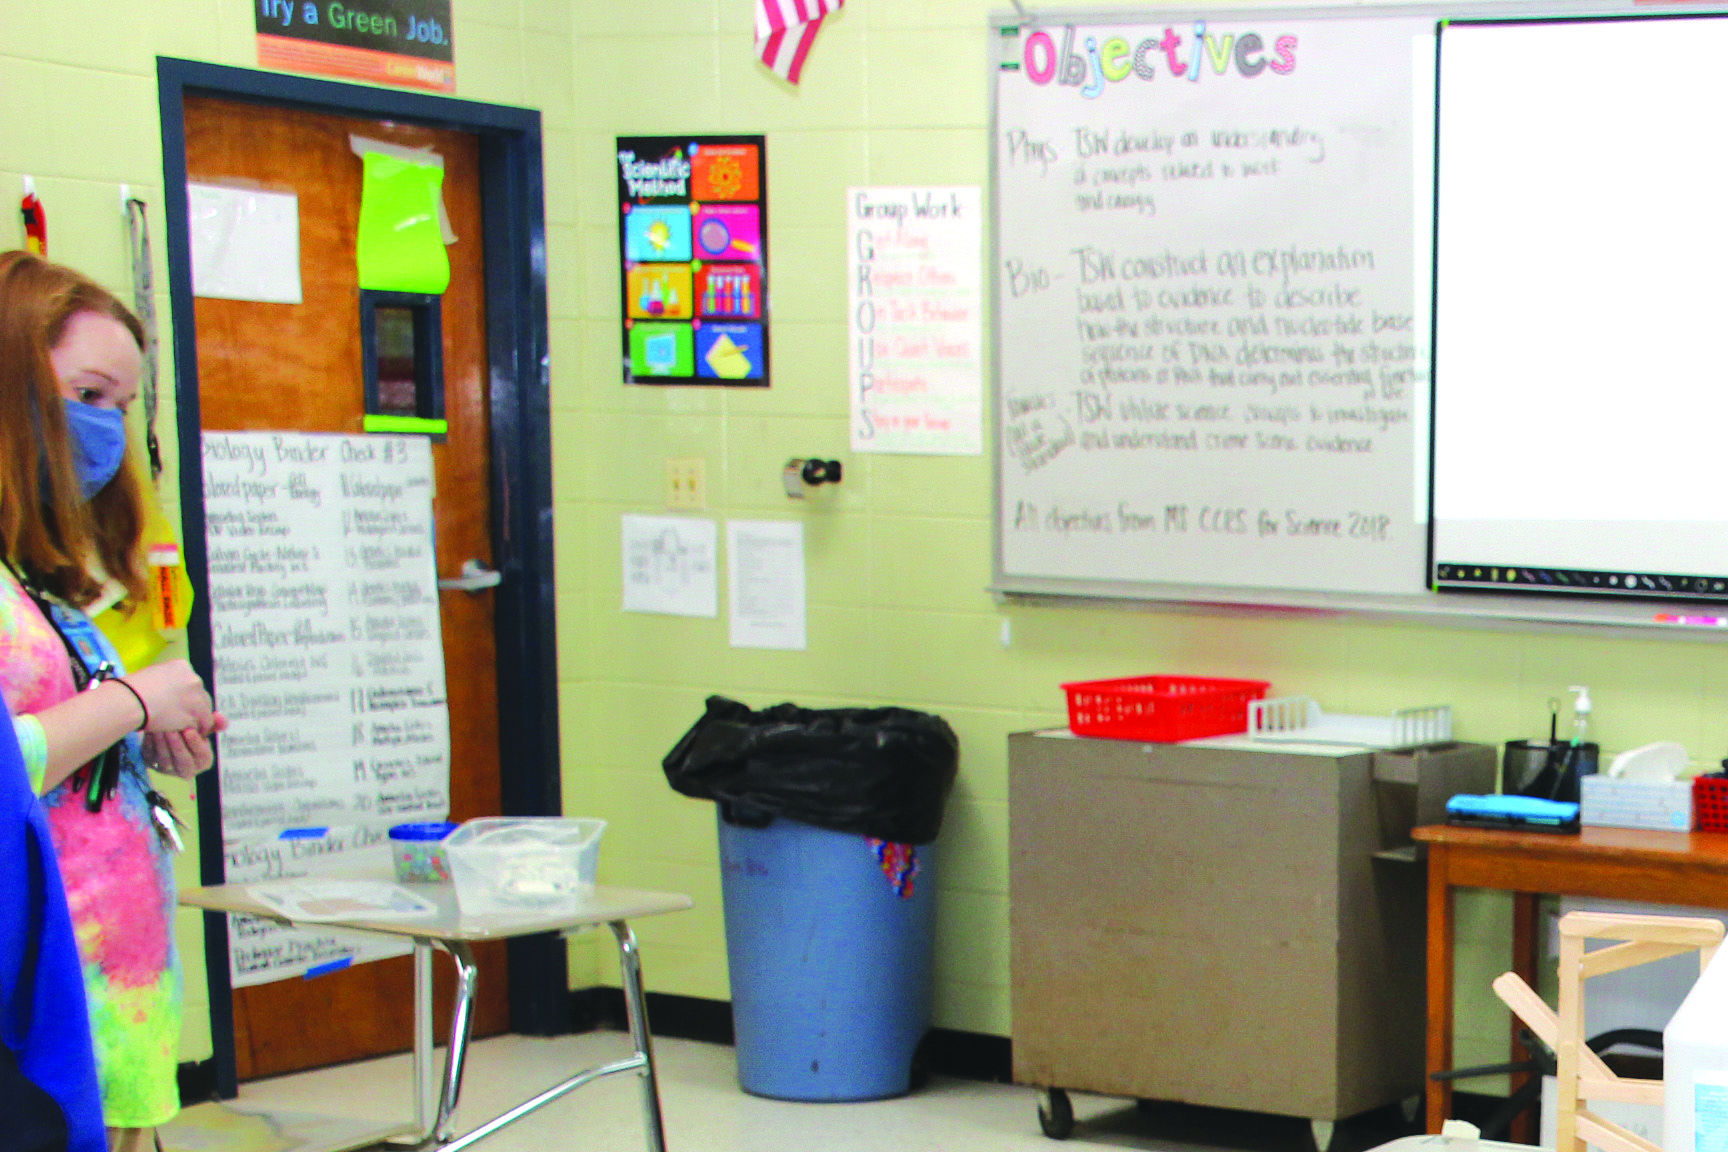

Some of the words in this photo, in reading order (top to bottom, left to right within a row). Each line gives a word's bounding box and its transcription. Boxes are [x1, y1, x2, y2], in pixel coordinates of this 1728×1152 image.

[303, 2, 318, 25] a
[327, 2, 398, 37] Green
[406, 15, 450, 46] Job.
[1024, 20, 1298, 99] Objectives
[621, 157, 691, 181] Scientific
[855, 190, 909, 226] Group
[911, 190, 963, 219] Work
[1250, 244, 1375, 287] explanation
